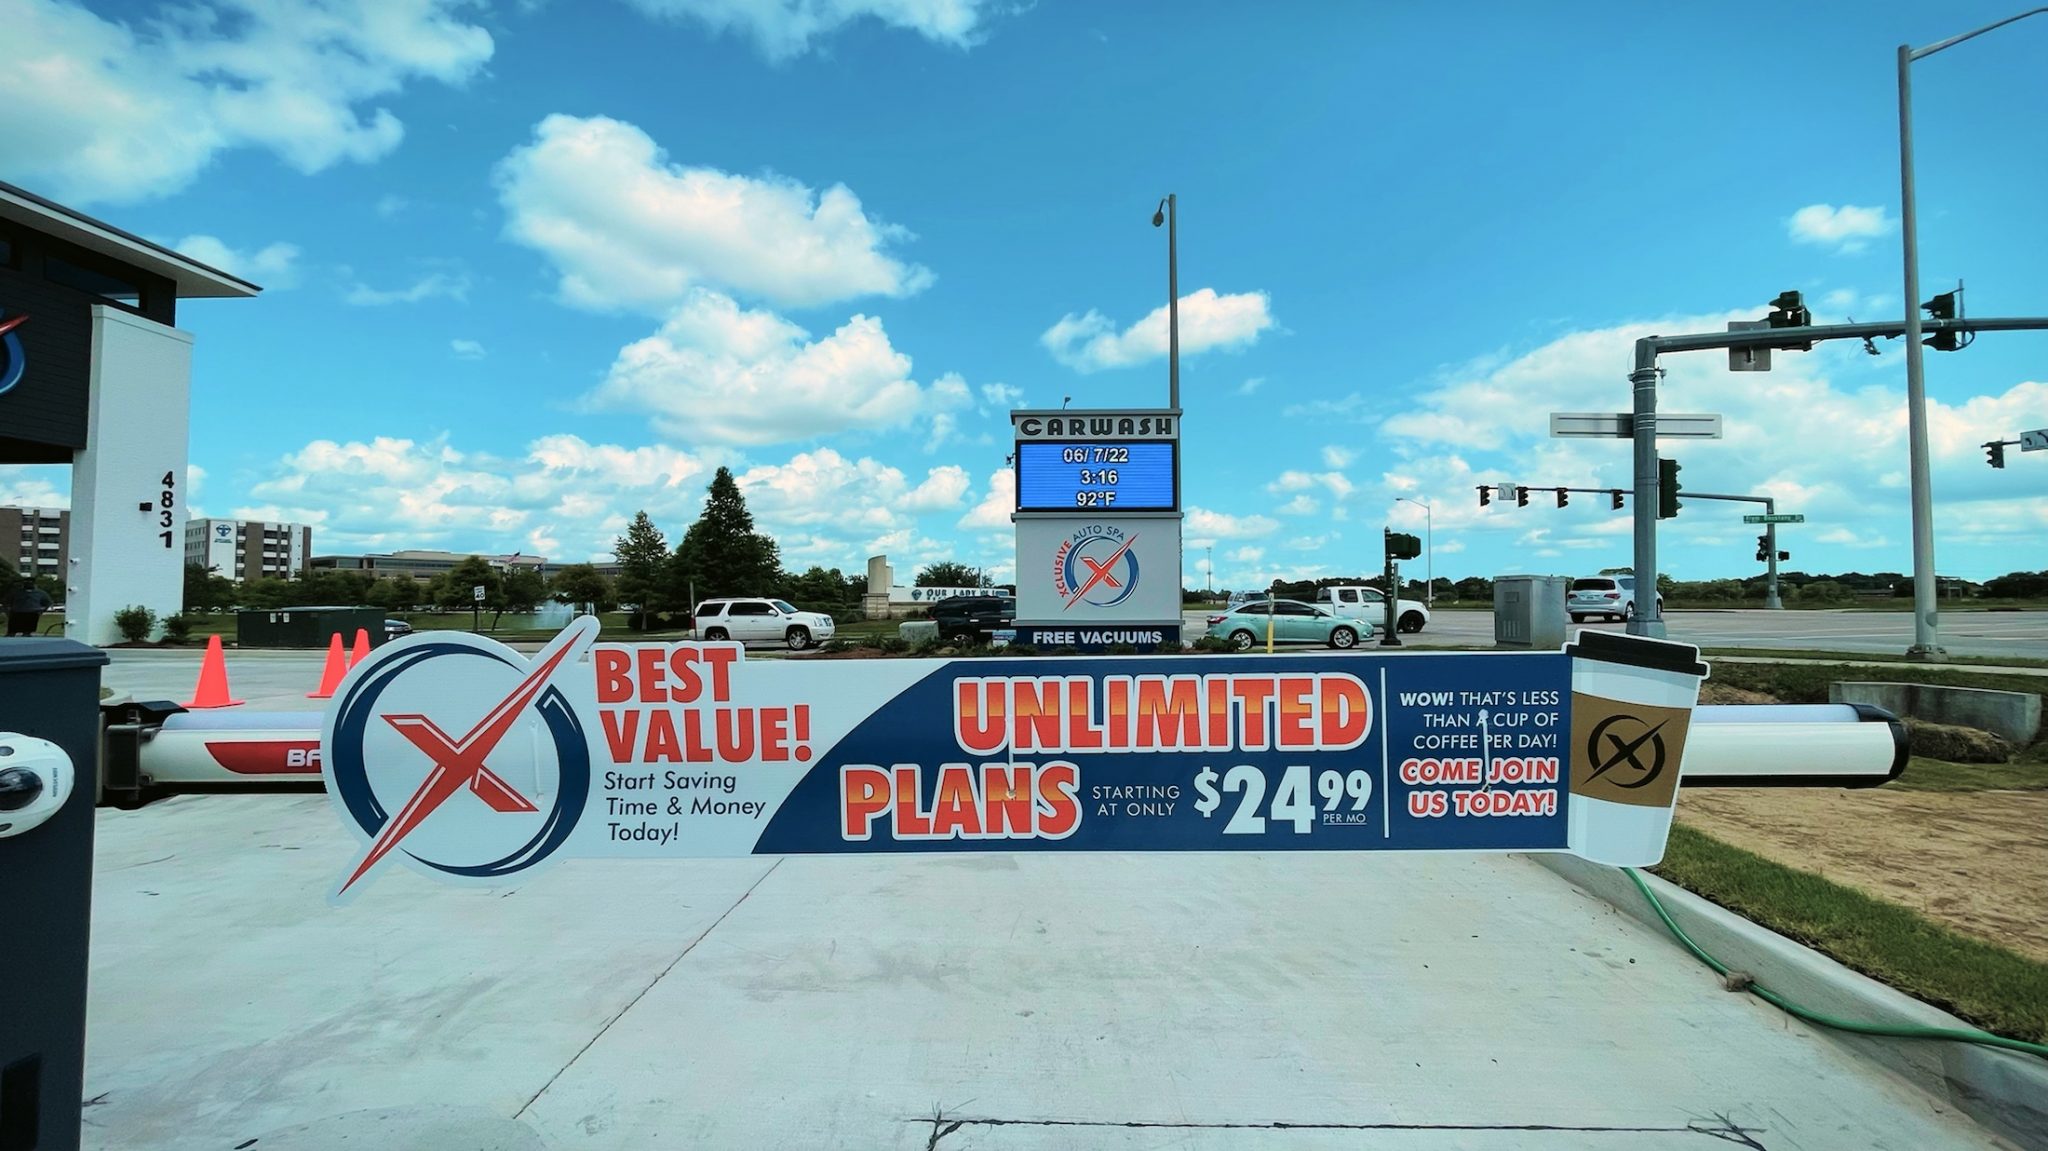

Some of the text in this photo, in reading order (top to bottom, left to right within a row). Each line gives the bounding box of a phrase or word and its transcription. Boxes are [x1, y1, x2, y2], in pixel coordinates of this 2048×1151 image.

[1020, 418, 1172, 436] CARWASH
[1081, 469, 1118, 485] 3:16
[159, 471, 174, 548] 4831
[1077, 491, 1116, 507] 92°F
[1054, 525, 1124, 598] XCLUSIVE AUTO SPA
[926, 589, 947, 597] OUR
[1033, 631, 1163, 644] FREE VACUUMS
[595, 648, 737, 703] BEST
[1400, 691, 1559, 706] WOW! THAT'S LESS
[955, 673, 1372, 754] UNLIMITED
[1424, 713, 1470, 727] THAN
[1493, 713, 1529, 727] CUP
[1534, 713, 1559, 727] OF
[599, 705, 812, 763] VALUE!
[1413, 734, 1557, 749] COFFEE PER DAY!
[1401, 758, 1558, 783] COME JOIN
[604, 770, 737, 794] Start Saving
[1092, 785, 1181, 799] STARTING
[606, 796, 767, 820] Time & Money
[842, 763, 1081, 839] PLANS
[1097, 802, 1175, 816] AT ONLY
[1409, 791, 1557, 816] US TODAY!
[1323, 814, 1367, 823] PER MO
[607, 822, 679, 846] Today!
